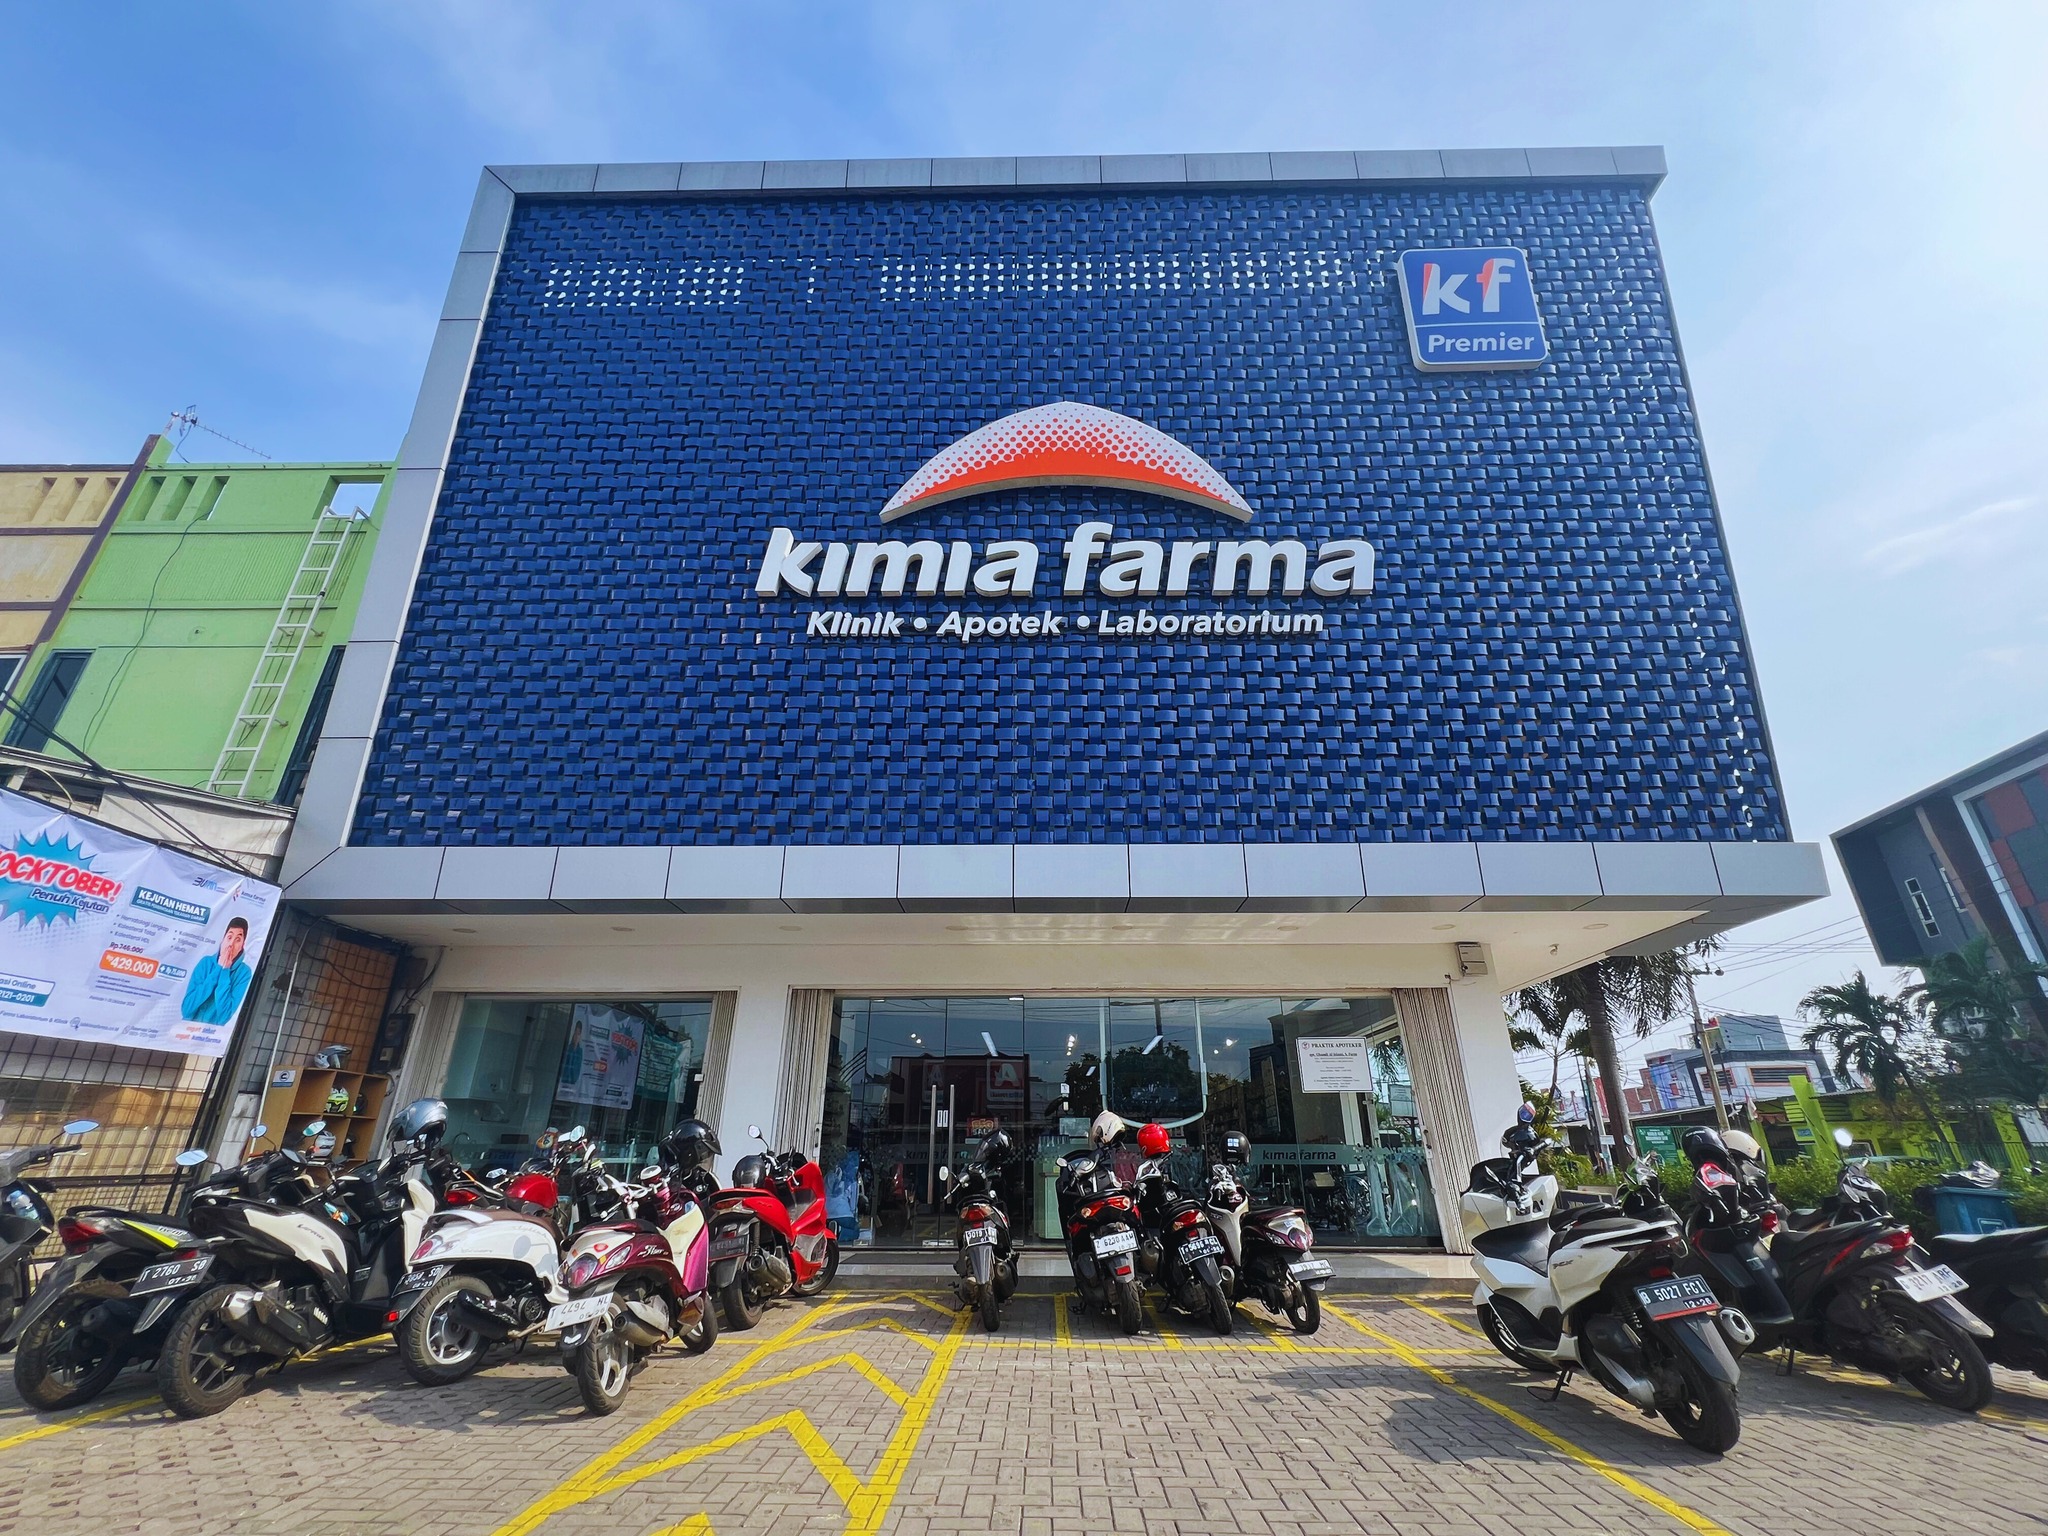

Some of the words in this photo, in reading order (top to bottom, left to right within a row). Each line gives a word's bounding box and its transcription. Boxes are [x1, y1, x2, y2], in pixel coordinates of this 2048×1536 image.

[1422, 258, 1516, 315] kf
[1428, 331, 1535, 353] Premier
[755, 527, 1039, 597] kimia
[1063, 522, 1376, 597] farma
[807, 611, 904, 638] Klinik
[936, 610, 1063, 644] Apotek
[1098, 609, 1324, 637] Laboratorium
[31, 888, 71, 904] Penuh
[71, 896, 110, 913] Kejutan
[138, 889, 175, 909] KEJUTAN
[175, 903, 207, 916] HEMAT
[12, 979, 36, 989] Online
[1262, 1149, 1297, 1160] kimia
[1299, 1149, 1336, 1161] farma
[152, 1263, 181, 1279] 2760
[1639, 1291, 1652, 1305] B
[1653, 1284, 1682, 1301] 5027
[550, 1307, 557, 1319] T
